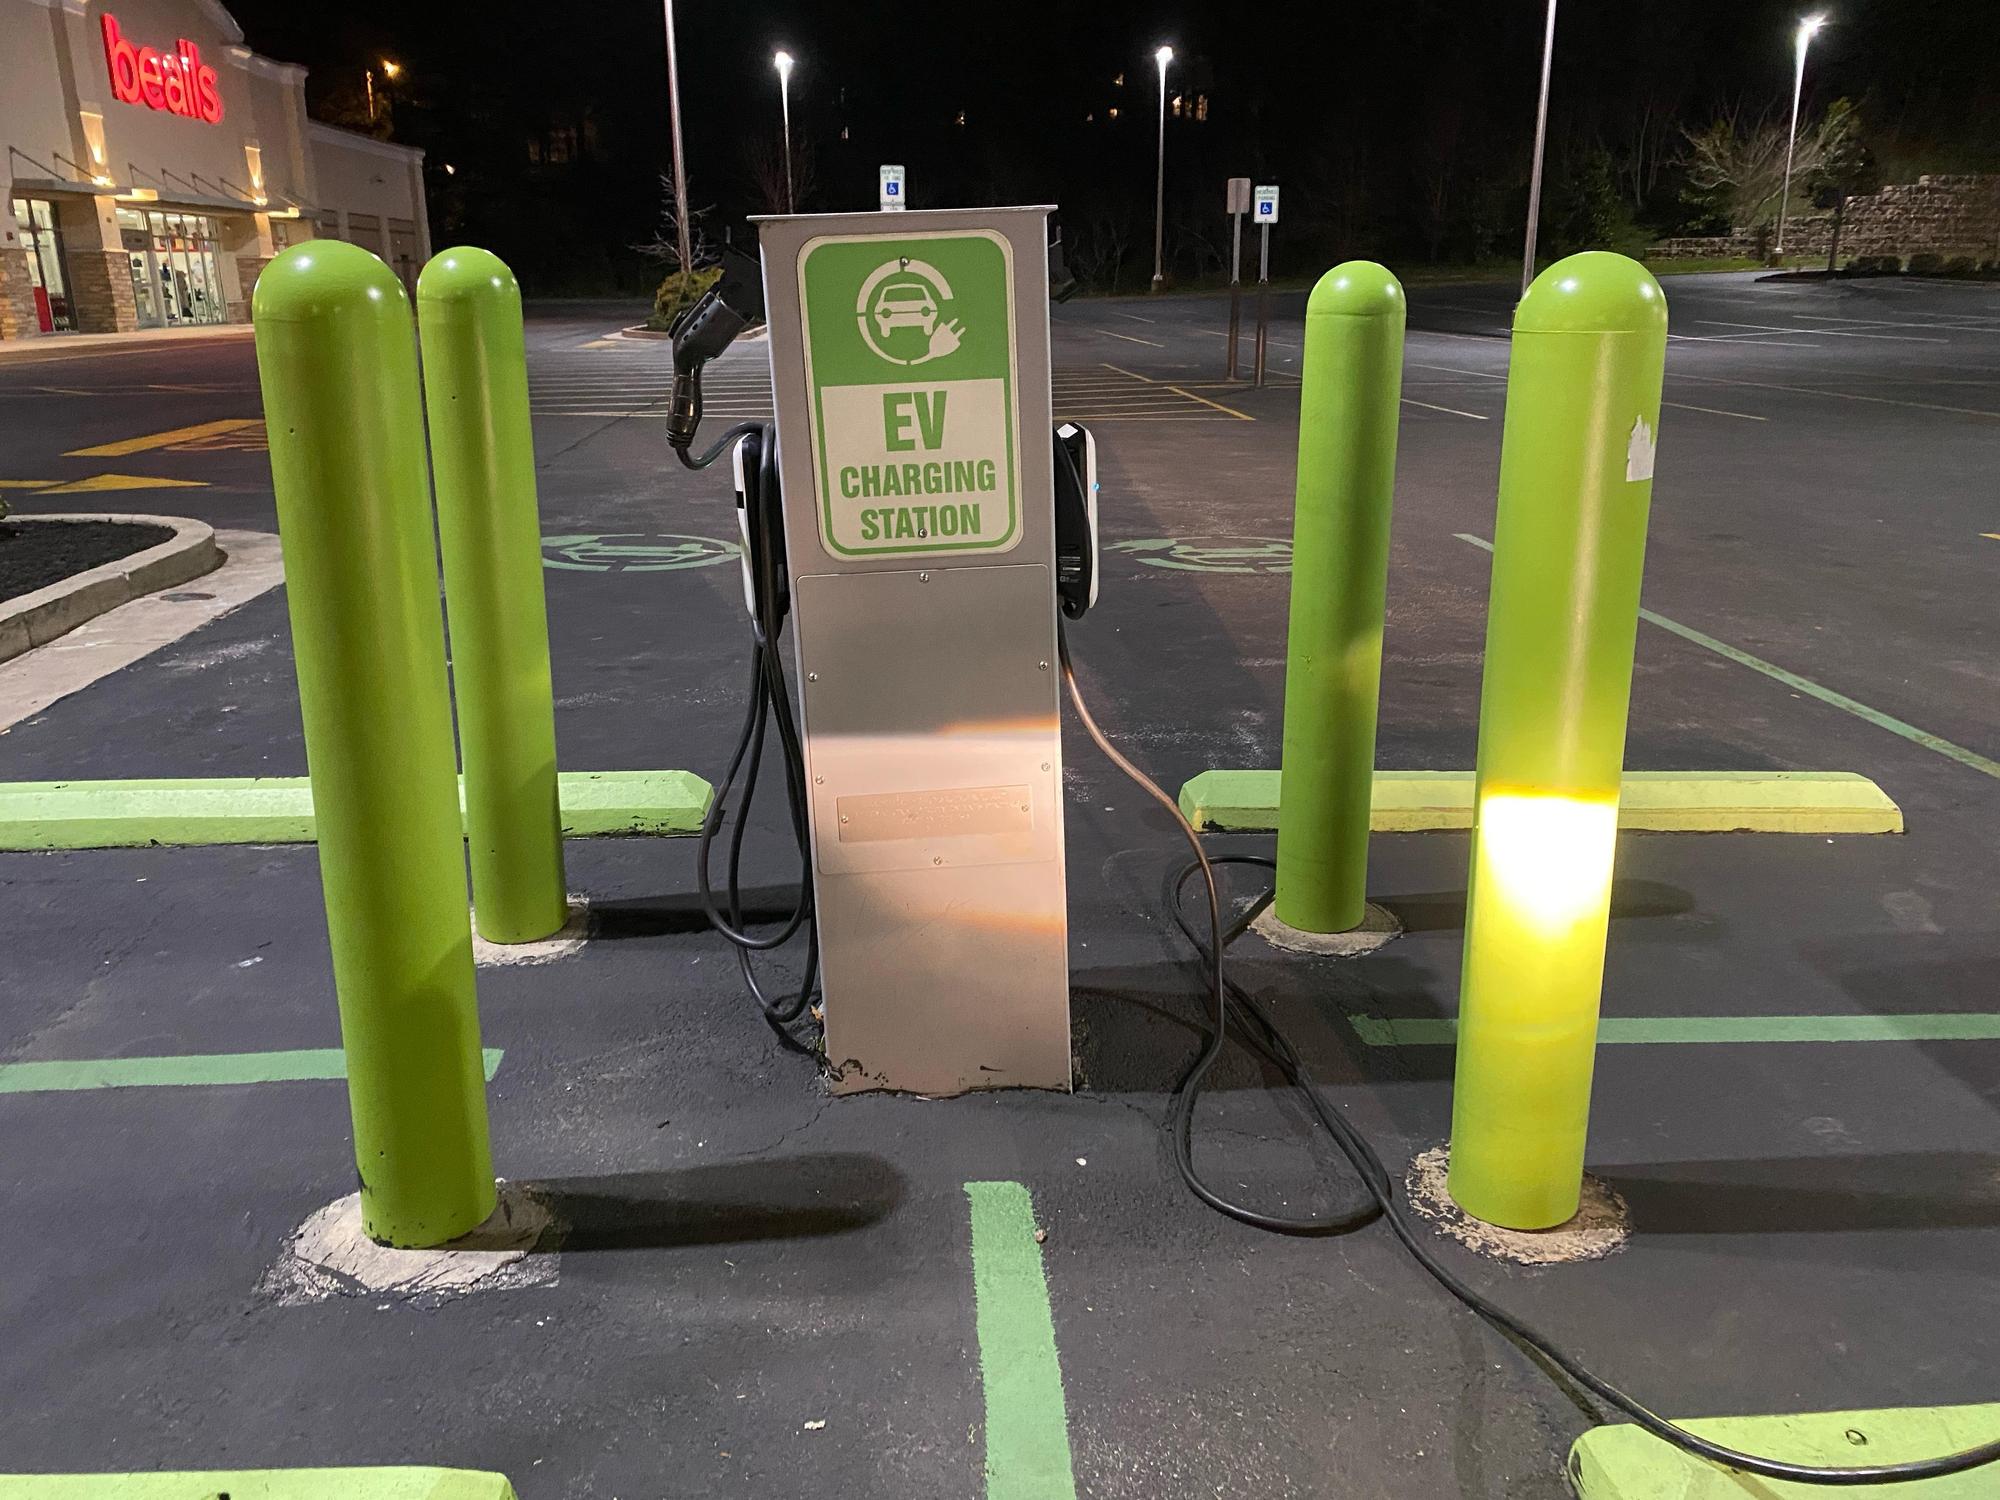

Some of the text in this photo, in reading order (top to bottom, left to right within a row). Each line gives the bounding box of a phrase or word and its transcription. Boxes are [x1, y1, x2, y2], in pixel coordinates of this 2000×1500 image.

[102, 13, 221, 123] bealls
[883, 391, 947, 452] EV
[840, 459, 996, 498] CHARGING
[861, 503, 981, 540] STATION
